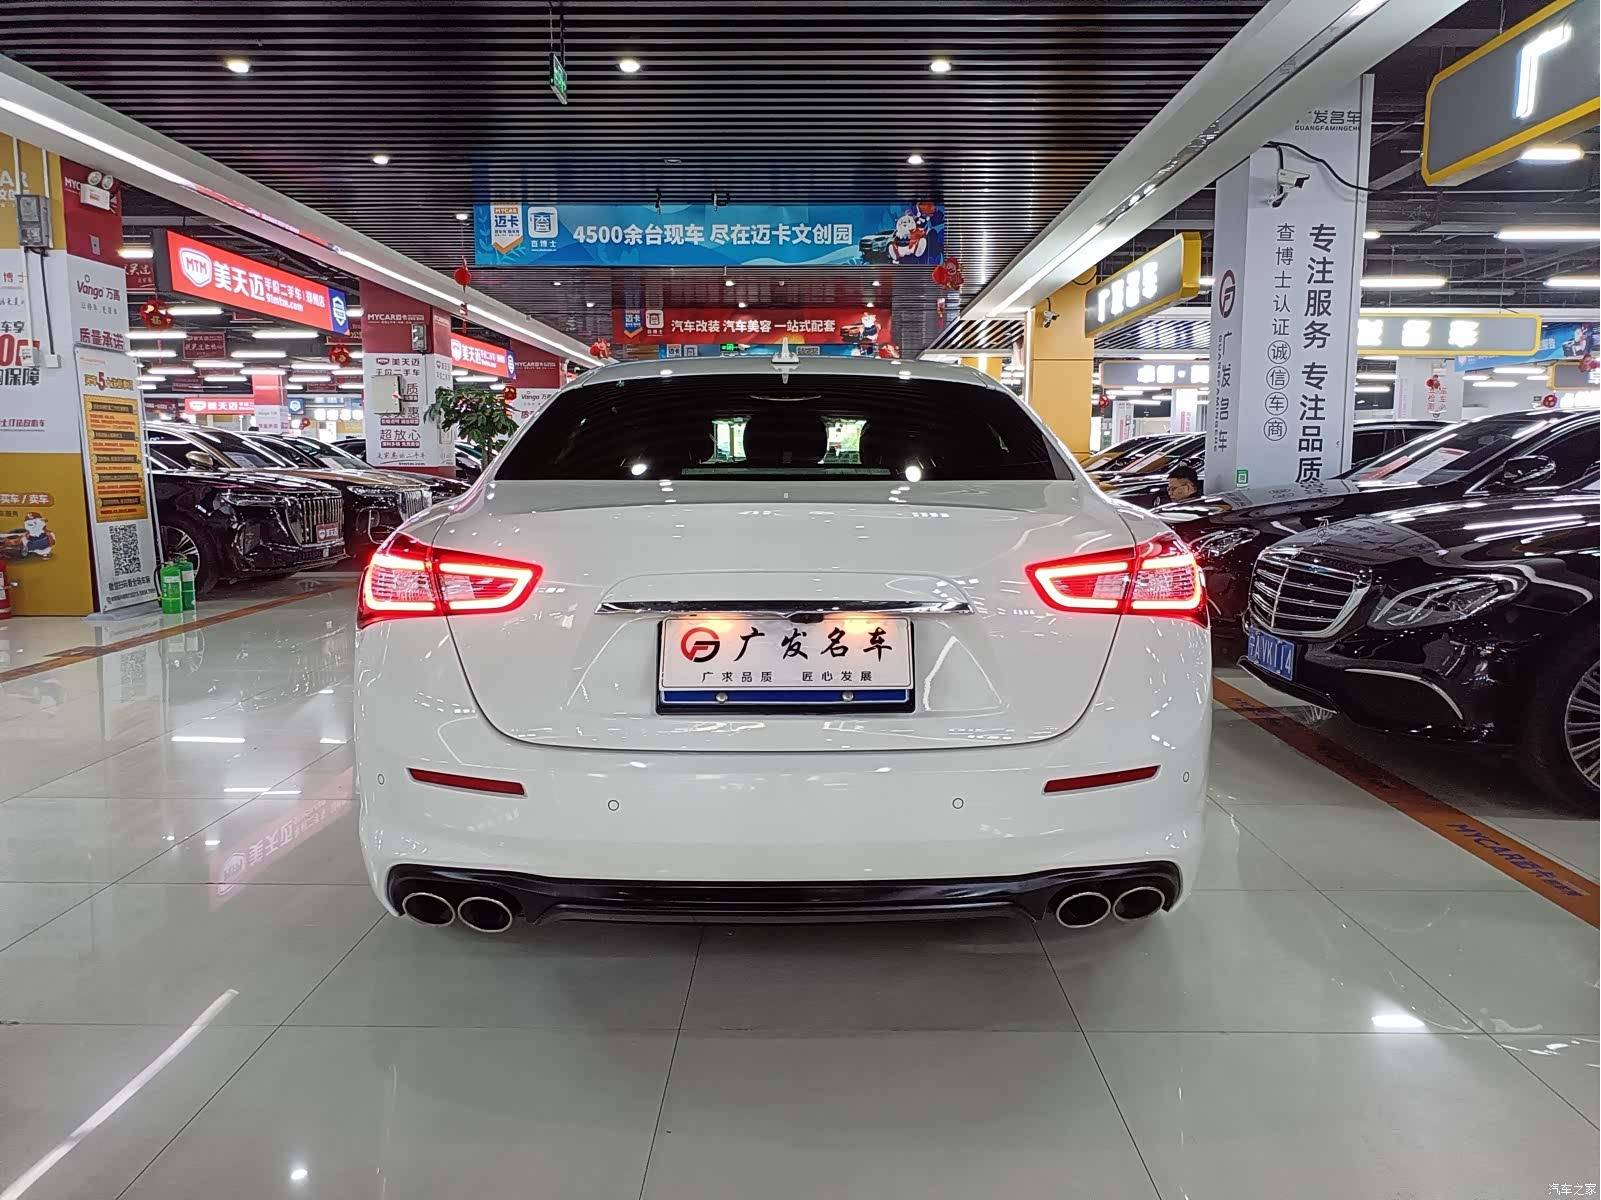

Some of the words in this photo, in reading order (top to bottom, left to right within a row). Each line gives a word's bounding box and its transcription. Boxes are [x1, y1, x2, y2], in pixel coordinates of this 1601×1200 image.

[495, 215, 518, 228] 迈卡
[573, 224, 704, 245] 4500余台现车
[710, 223, 853, 245] 尽在迈卡文创园
[186, 256, 207, 275] MTM
[77, 281, 104, 300] Vango
[213, 261, 265, 302] 美天迈
[1303, 224, 1337, 349] 专注服务
[671, 320, 720, 333] 汽车改装
[723, 320, 771, 333] 汽车美容
[774, 320, 836, 333] 一站式配套
[1264, 223, 1295, 441] 查博士认证诚信车商
[80, 328, 124, 350] 质量承诺
[392, 358, 420, 366] 美天迈
[1295, 362, 1328, 483] 专注品质
[380, 429, 421, 440] 超放心
[734, 627, 893, 662] 广发名车
[701, 671, 773, 683] 广求品质
[802, 671, 873, 683] 匠心发展
